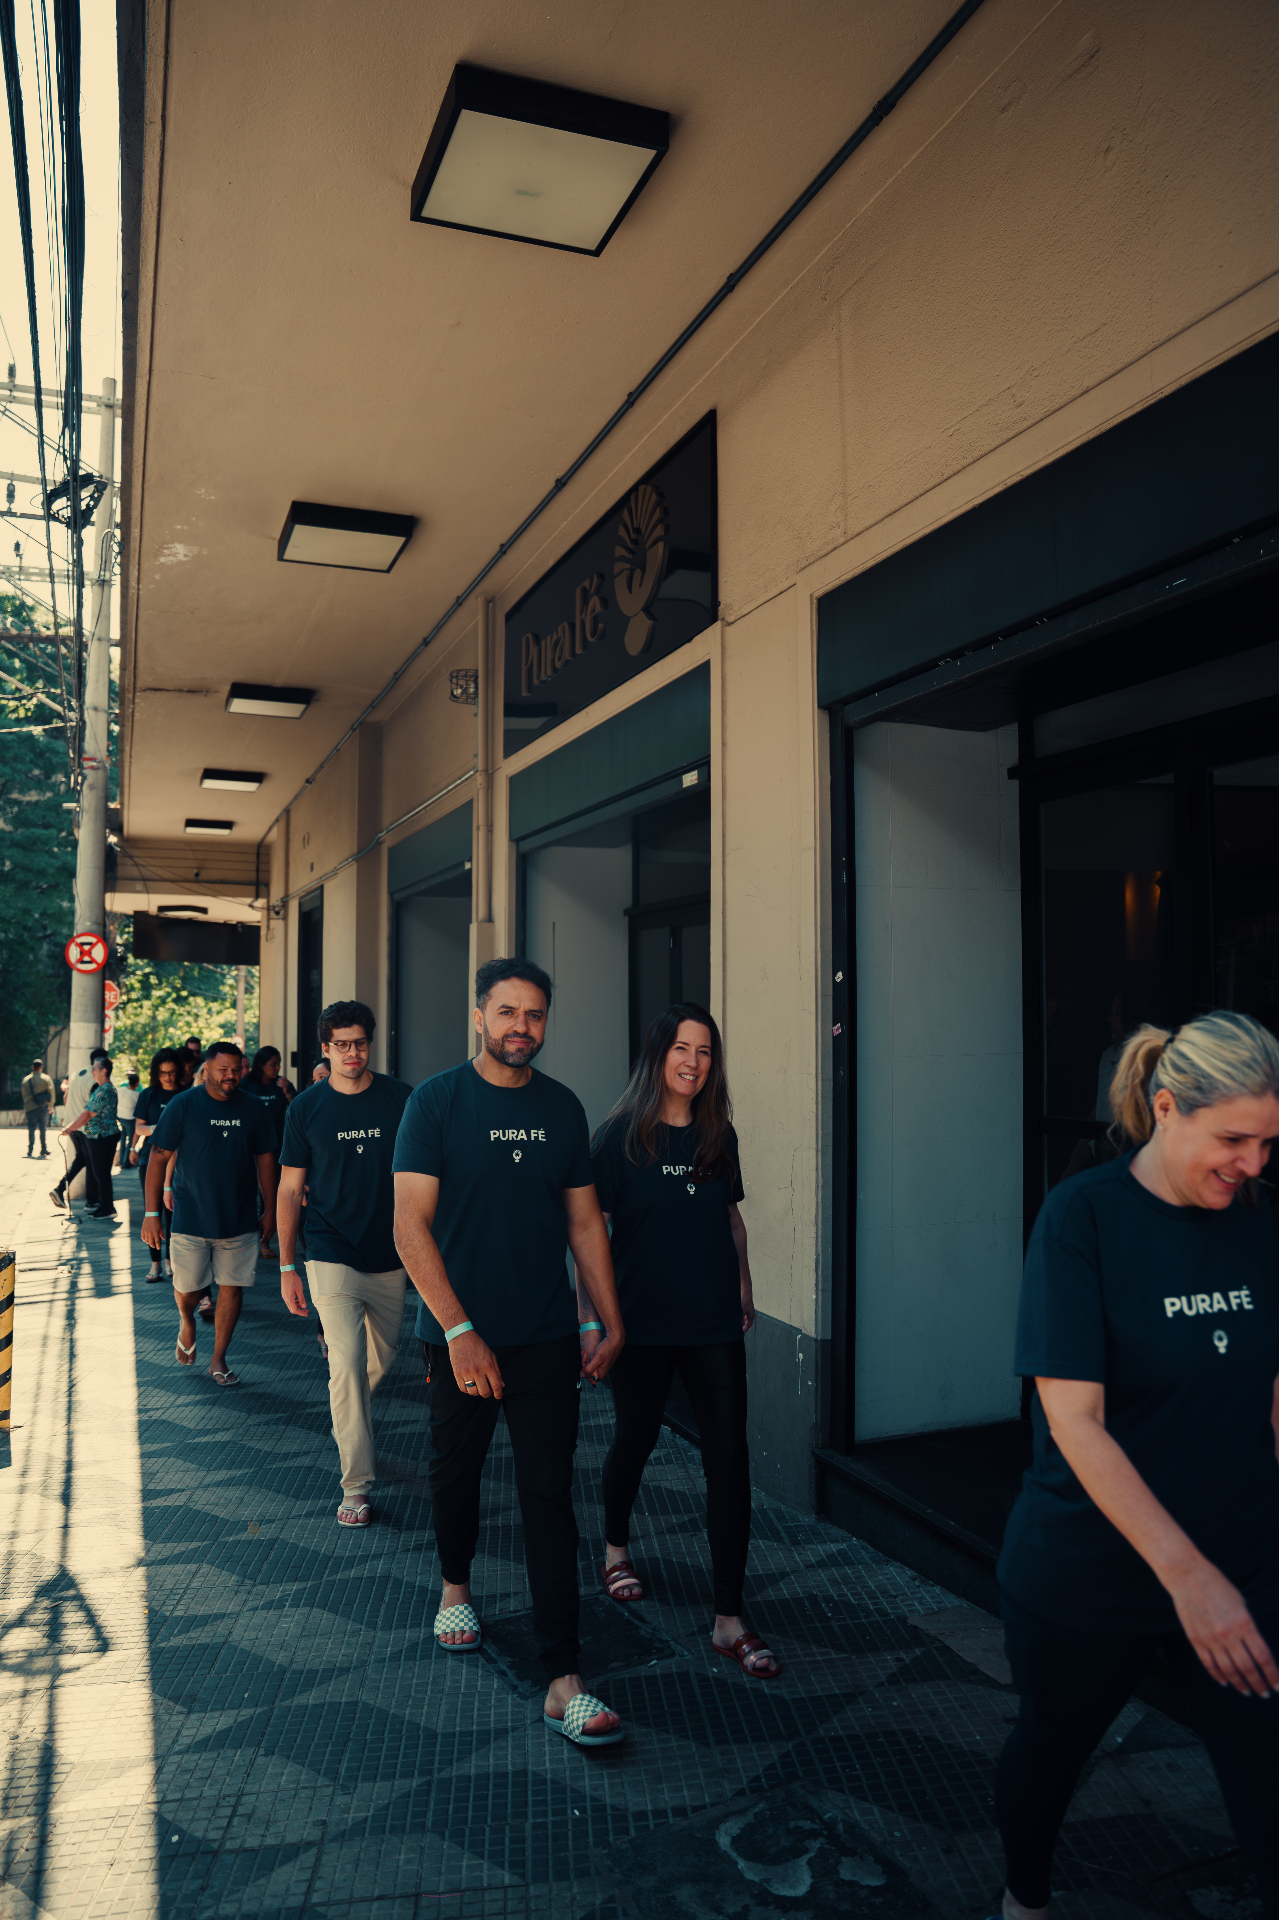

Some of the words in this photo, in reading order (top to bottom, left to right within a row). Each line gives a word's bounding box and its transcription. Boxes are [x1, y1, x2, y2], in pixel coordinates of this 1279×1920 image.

[521, 621, 575, 697] Pura
[574, 571, 608, 655] Fé
[104, 991, 117, 1002] RE
[210, 1119, 231, 1127] PURA
[231, 1118, 241, 1127] FÉ
[337, 1130, 367, 1141] PURA
[367, 1127, 381, 1138] FÉ
[489, 1129, 528, 1141] PURA
[530, 1127, 547, 1142] FÉ
[1163, 1291, 1228, 1318] PURA
[1228, 1285, 1255, 1311] FÉ
